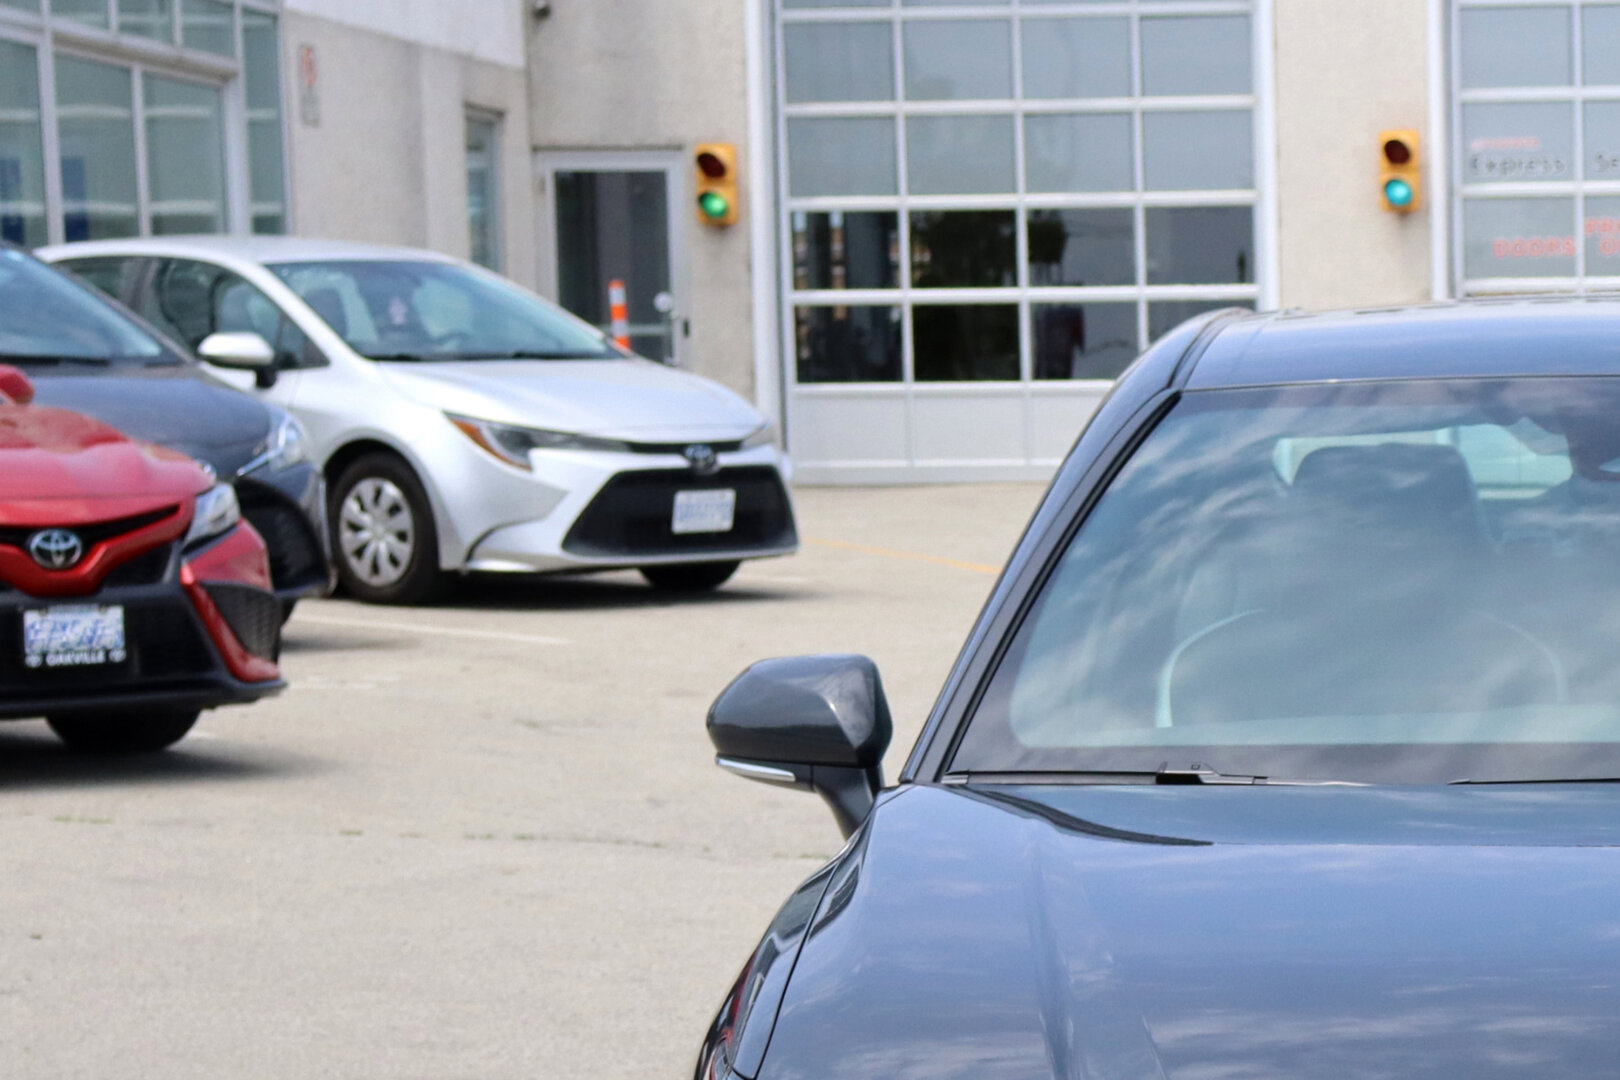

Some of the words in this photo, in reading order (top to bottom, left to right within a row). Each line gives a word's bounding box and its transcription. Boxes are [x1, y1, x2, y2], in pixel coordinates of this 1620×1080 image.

[1470, 152, 1565, 176] Express
[1492, 236, 1576, 258] DOORS
[46, 649, 106, 666] OAKVILLE
